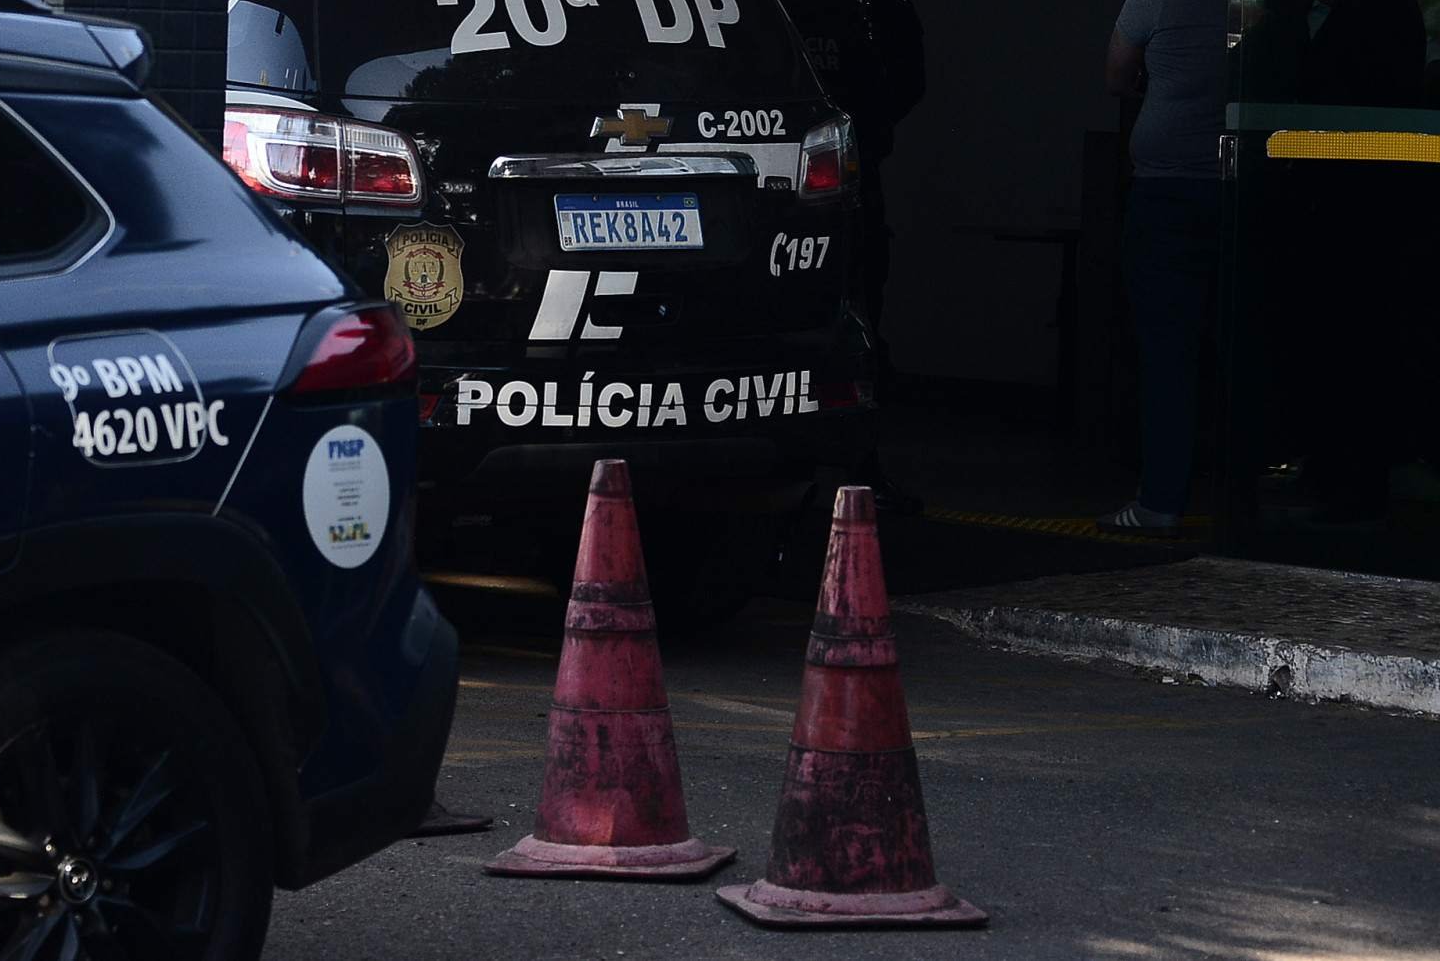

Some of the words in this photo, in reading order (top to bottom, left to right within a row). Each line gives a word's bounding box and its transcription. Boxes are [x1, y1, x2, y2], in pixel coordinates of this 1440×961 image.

[697, 109, 787, 139] C-2002
[615, 200, 639, 208] BRASIL
[571, 212, 689, 245] REK8A42
[786, 236, 830, 272] 197
[404, 302, 442, 315] CIVIL
[92, 353, 184, 399] BPM
[456, 371, 688, 428] POLÍCIA
[703, 370, 820, 423] CIVIL
[72, 406, 159, 458] 4620
[160, 399, 230, 451] VPC
